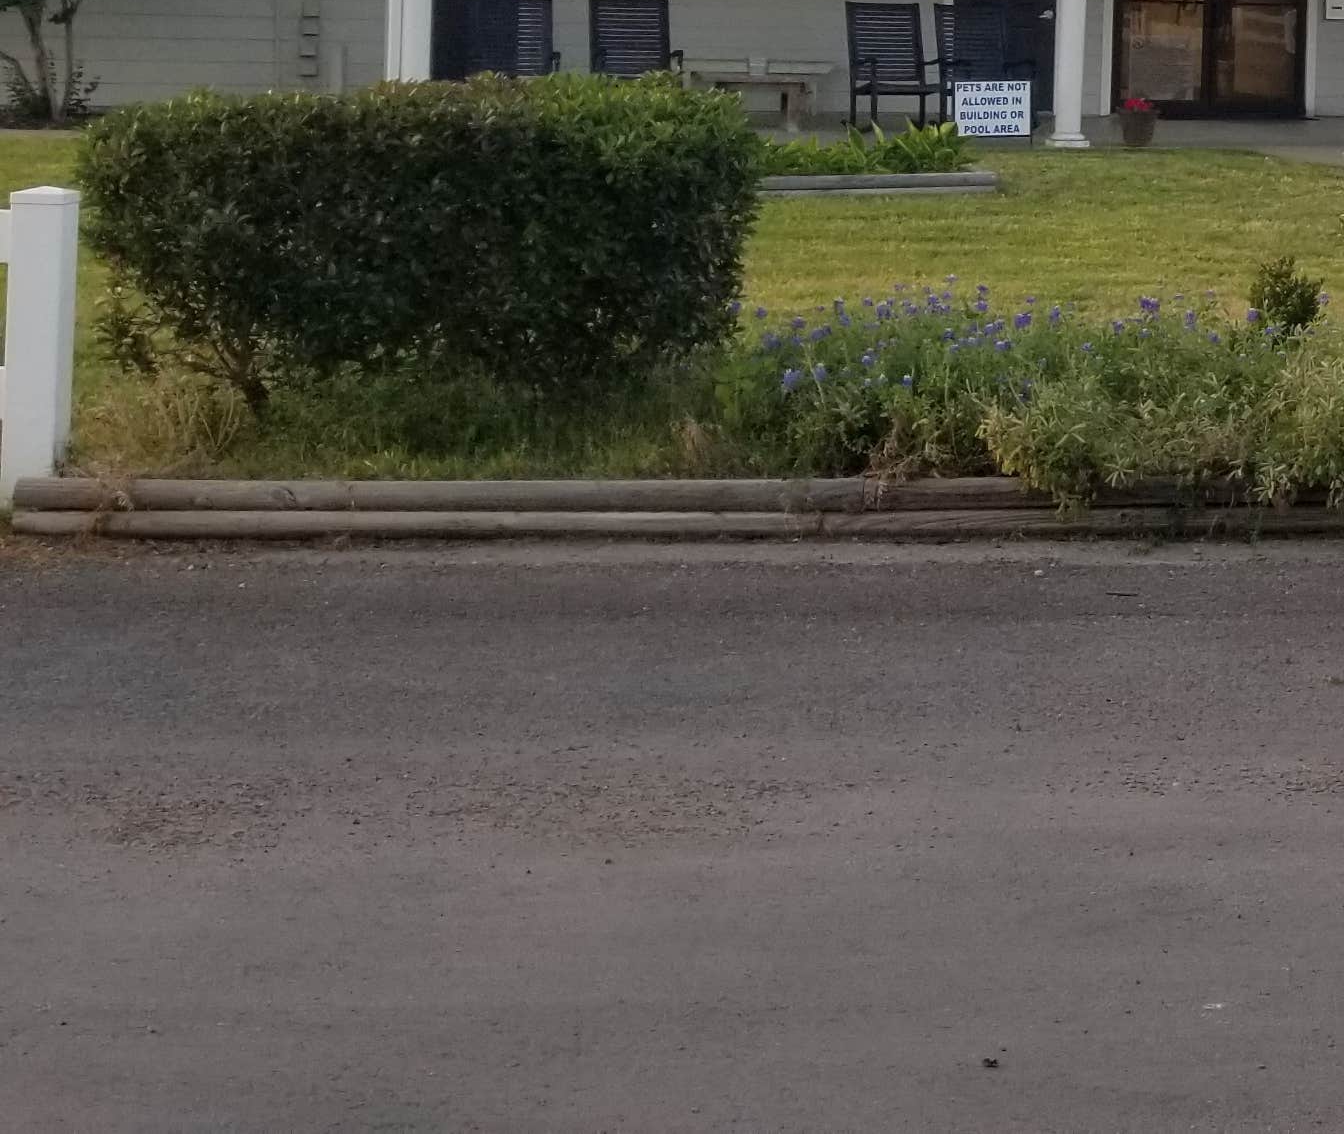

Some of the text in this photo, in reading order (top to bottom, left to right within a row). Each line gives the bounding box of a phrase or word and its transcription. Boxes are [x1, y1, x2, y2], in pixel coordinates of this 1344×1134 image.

[956, 83, 1027, 92] PETS ARE NOT
[961, 97, 1022, 106] ALLOWED IN
[960, 111, 1024, 120] BUILDING OR
[964, 125, 1020, 134] POOL AREA
